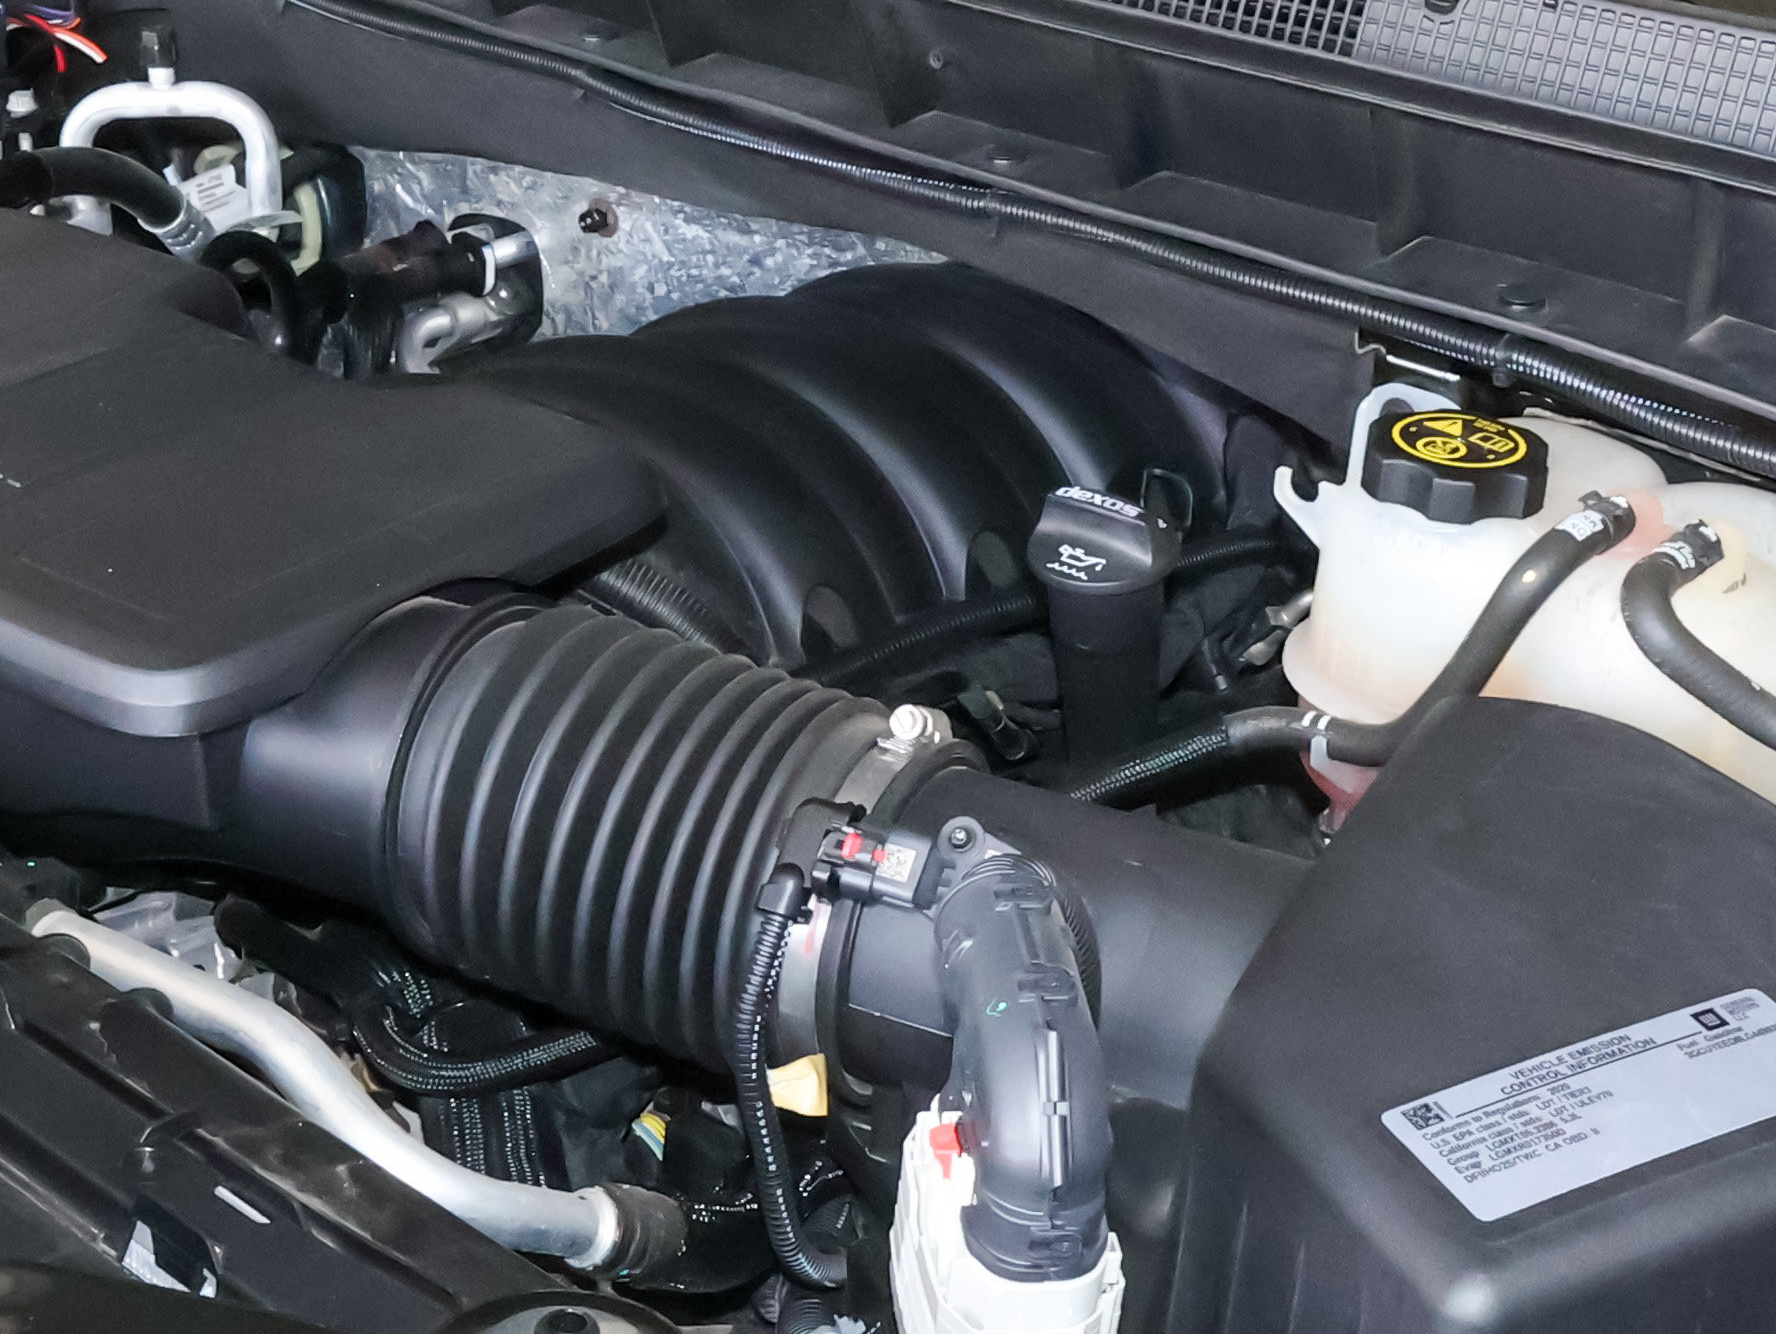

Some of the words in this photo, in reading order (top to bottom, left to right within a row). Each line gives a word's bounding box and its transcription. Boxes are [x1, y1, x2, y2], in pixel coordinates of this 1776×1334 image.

[1055, 485, 1146, 517] dexos
[1500, 1067, 1568, 1095] CONTROL
[1567, 1036, 1659, 1073] INFORMATION
[1508, 1054, 1568, 1081] VEHICLE
[1569, 1033, 1633, 1061] EMISSION
[1421, 1119, 1472, 1141] Conforms
[1470, 1115, 1483, 1123] to
[1438, 1136, 1488, 1157] California
[1487, 1126, 1514, 1139] class
[1547, 1104, 1569, 1117] LDT
[1451, 1128, 1475, 1141] EPA
[1474, 1119, 1502, 1133] class
[1534, 1097, 1557, 1110] LDT
[1544, 1141, 1563, 1151] CA
[1561, 1131, 1588, 1145] OBD
